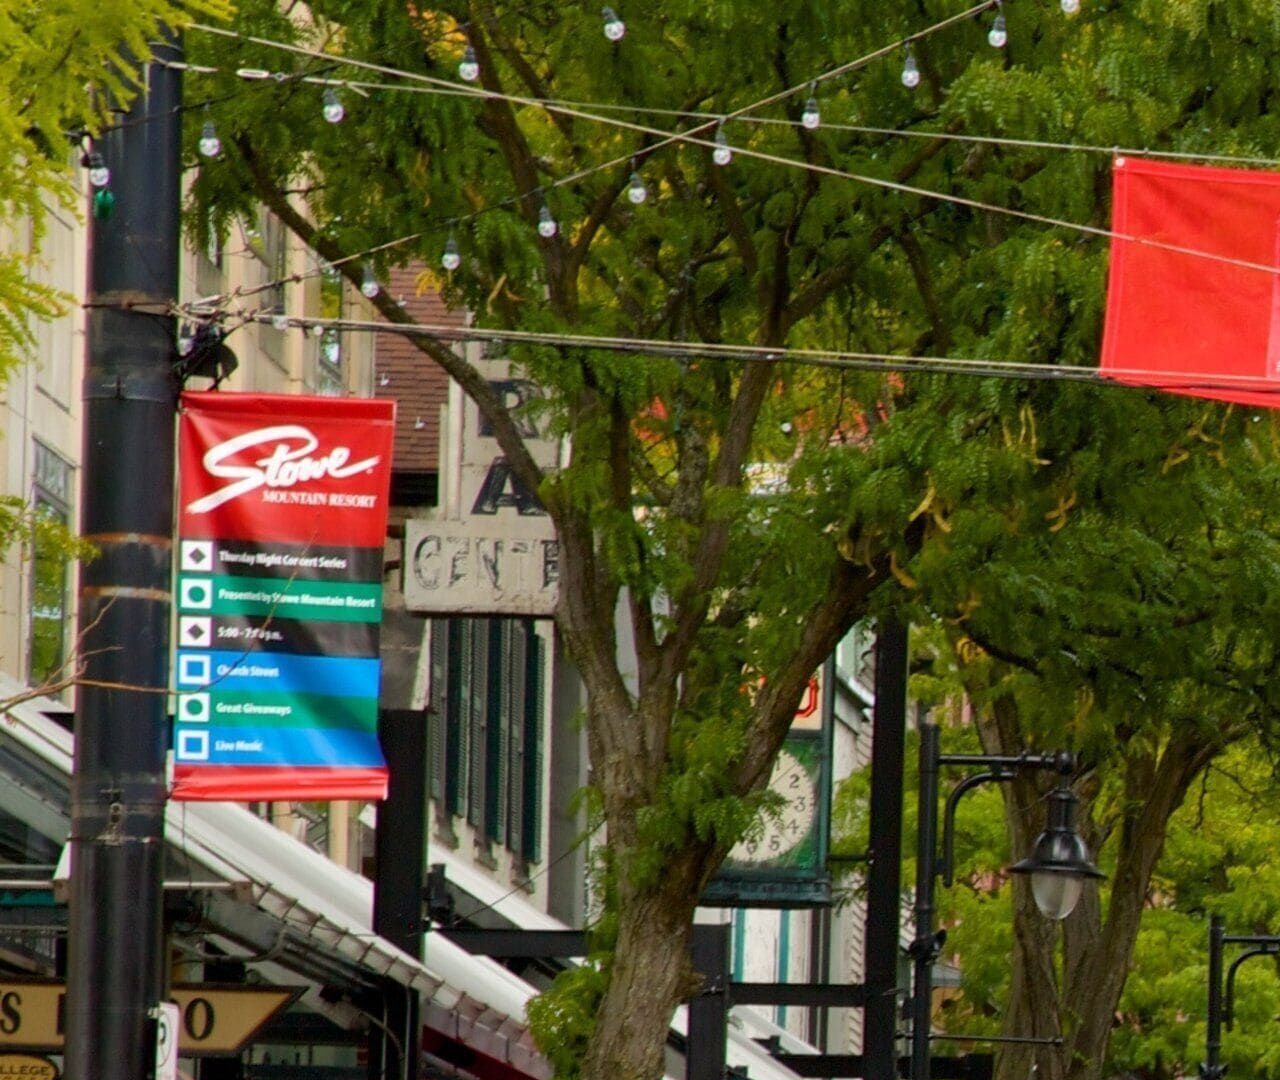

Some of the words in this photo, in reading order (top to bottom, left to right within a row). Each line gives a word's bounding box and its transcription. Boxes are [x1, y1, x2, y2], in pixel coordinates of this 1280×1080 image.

[185, 424, 383, 514] Stowe
[262, 490, 327, 506] MOUNTAIN
[328, 492, 378, 509] RESORT
[256, 552, 282, 567] Night
[318, 556, 347, 569] Series
[218, 589, 260, 600] Presented
[300, 595, 345, 606] Mountain
[345, 596, 376, 608] Resort
[250, 666, 279, 678] Street
[216, 702, 242, 714] Great
[243, 703, 292, 716] Giveaways
[215, 740, 235, 751] Live
[235, 741, 263, 752] Music
